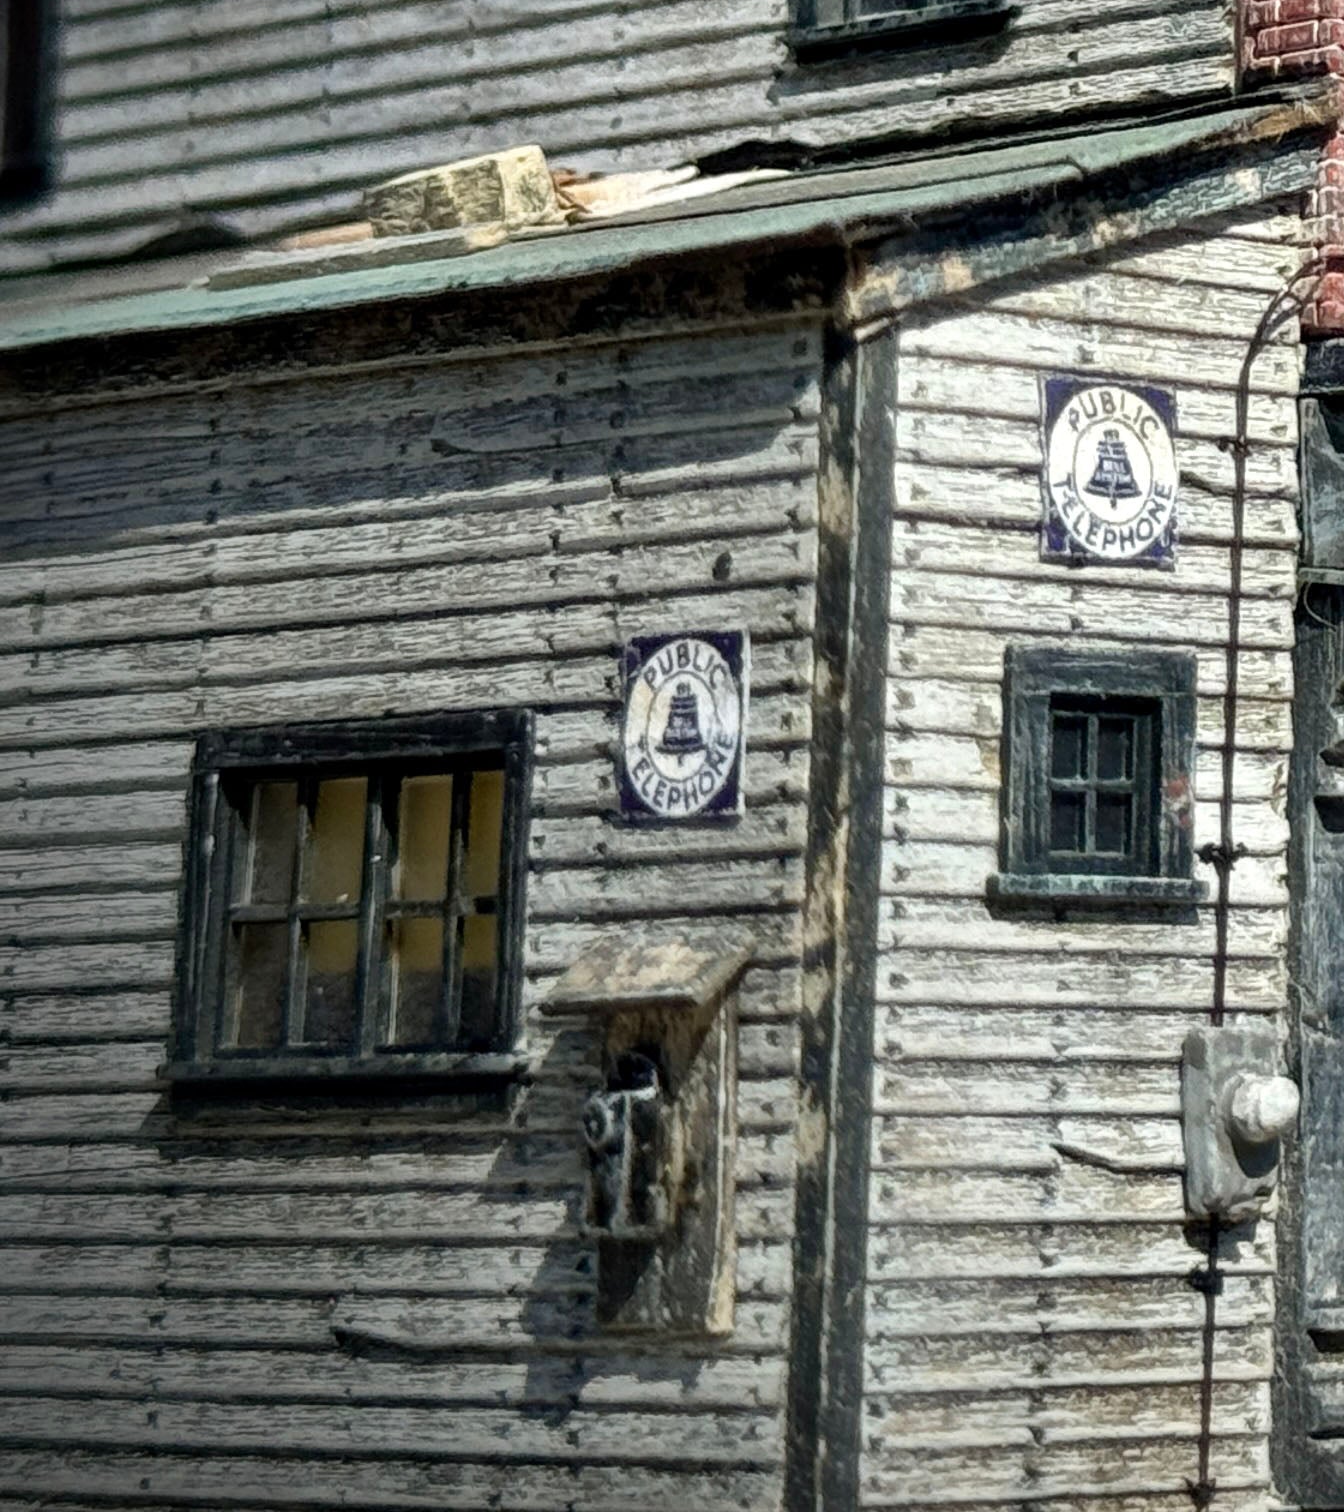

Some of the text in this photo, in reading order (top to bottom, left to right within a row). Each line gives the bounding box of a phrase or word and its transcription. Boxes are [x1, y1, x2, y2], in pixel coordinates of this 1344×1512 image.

[1067, 390, 1161, 441] PUBLIC
[1052, 471, 1174, 553] TELEPHONE
[643, 641, 728, 691] PUBLIC
[632, 731, 734, 812] TELEPHONE
